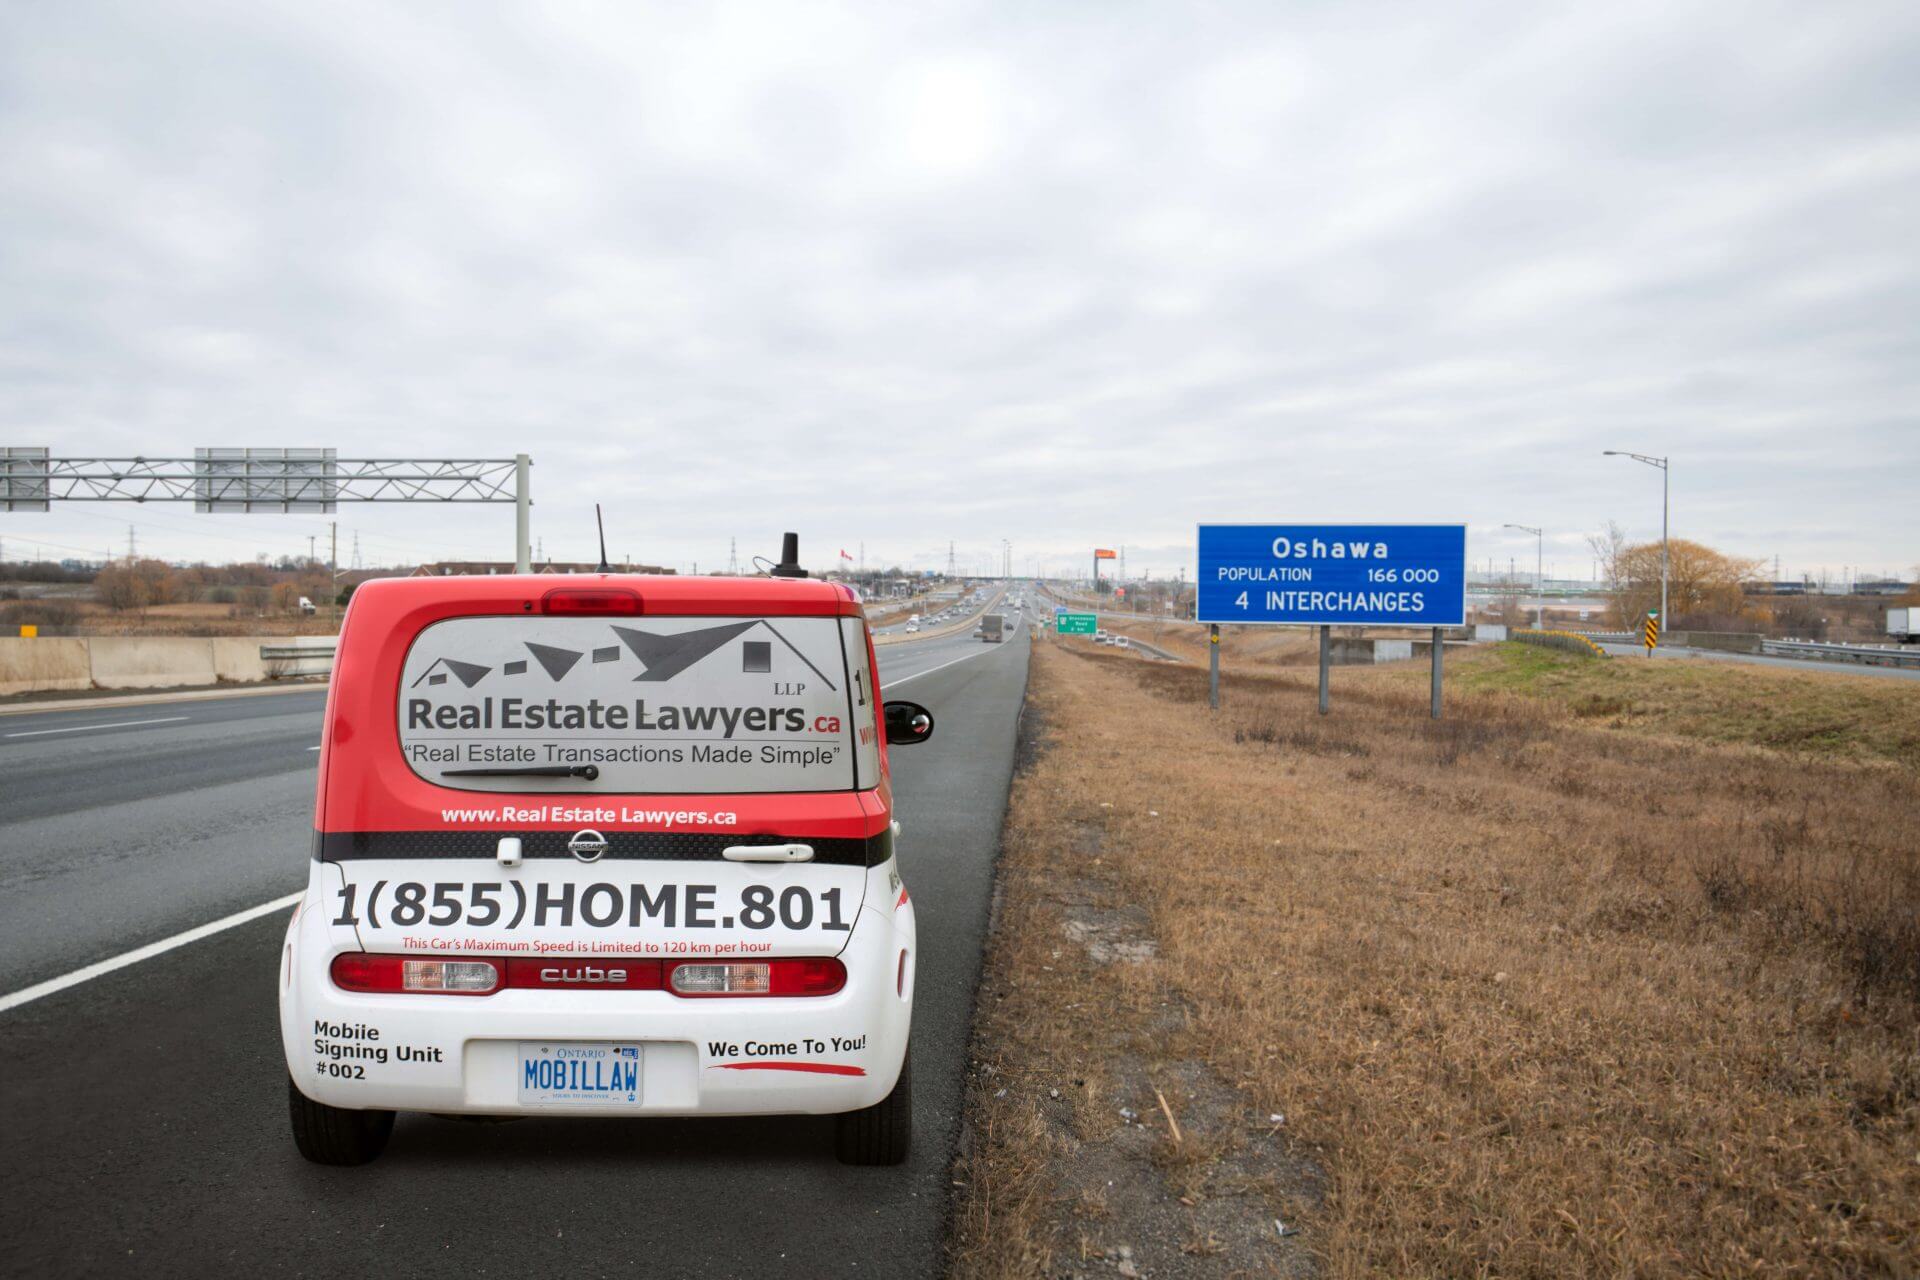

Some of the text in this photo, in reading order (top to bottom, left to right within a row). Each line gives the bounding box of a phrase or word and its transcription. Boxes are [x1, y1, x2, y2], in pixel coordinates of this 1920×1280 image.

[1272, 537, 1389, 559] Oshawa
[1218, 567, 1313, 582] POPULATION
[1234, 591, 1425, 612] 4 INTERCHANGES
[773, 682, 806, 696] LLP
[468, 744, 536, 763] Estate
[543, 744, 684, 763] Transactions
[691, 745, 753, 764] Made
[402, 937, 428, 949] This
[464, 938, 530, 951] Maximum
[533, 939, 574, 955] Speed
[578, 940, 588, 952] is
[592, 941, 642, 953] Limited
[645, 942, 659, 953] to
[664, 942, 687, 953] 120
[691, 941, 711, 953] km
[715, 943, 737, 956] per
[740, 941, 772, 952] hour
[540, 966, 628, 983] cube
[314, 1038, 443, 1064] Signing Unit
[557, 1048, 606, 1059] ONTARIO
[708, 1034, 867, 1057] We Come To You!
[316, 1061, 366, 1080] #002
[525, 1059, 638, 1091] MOBILLAW
